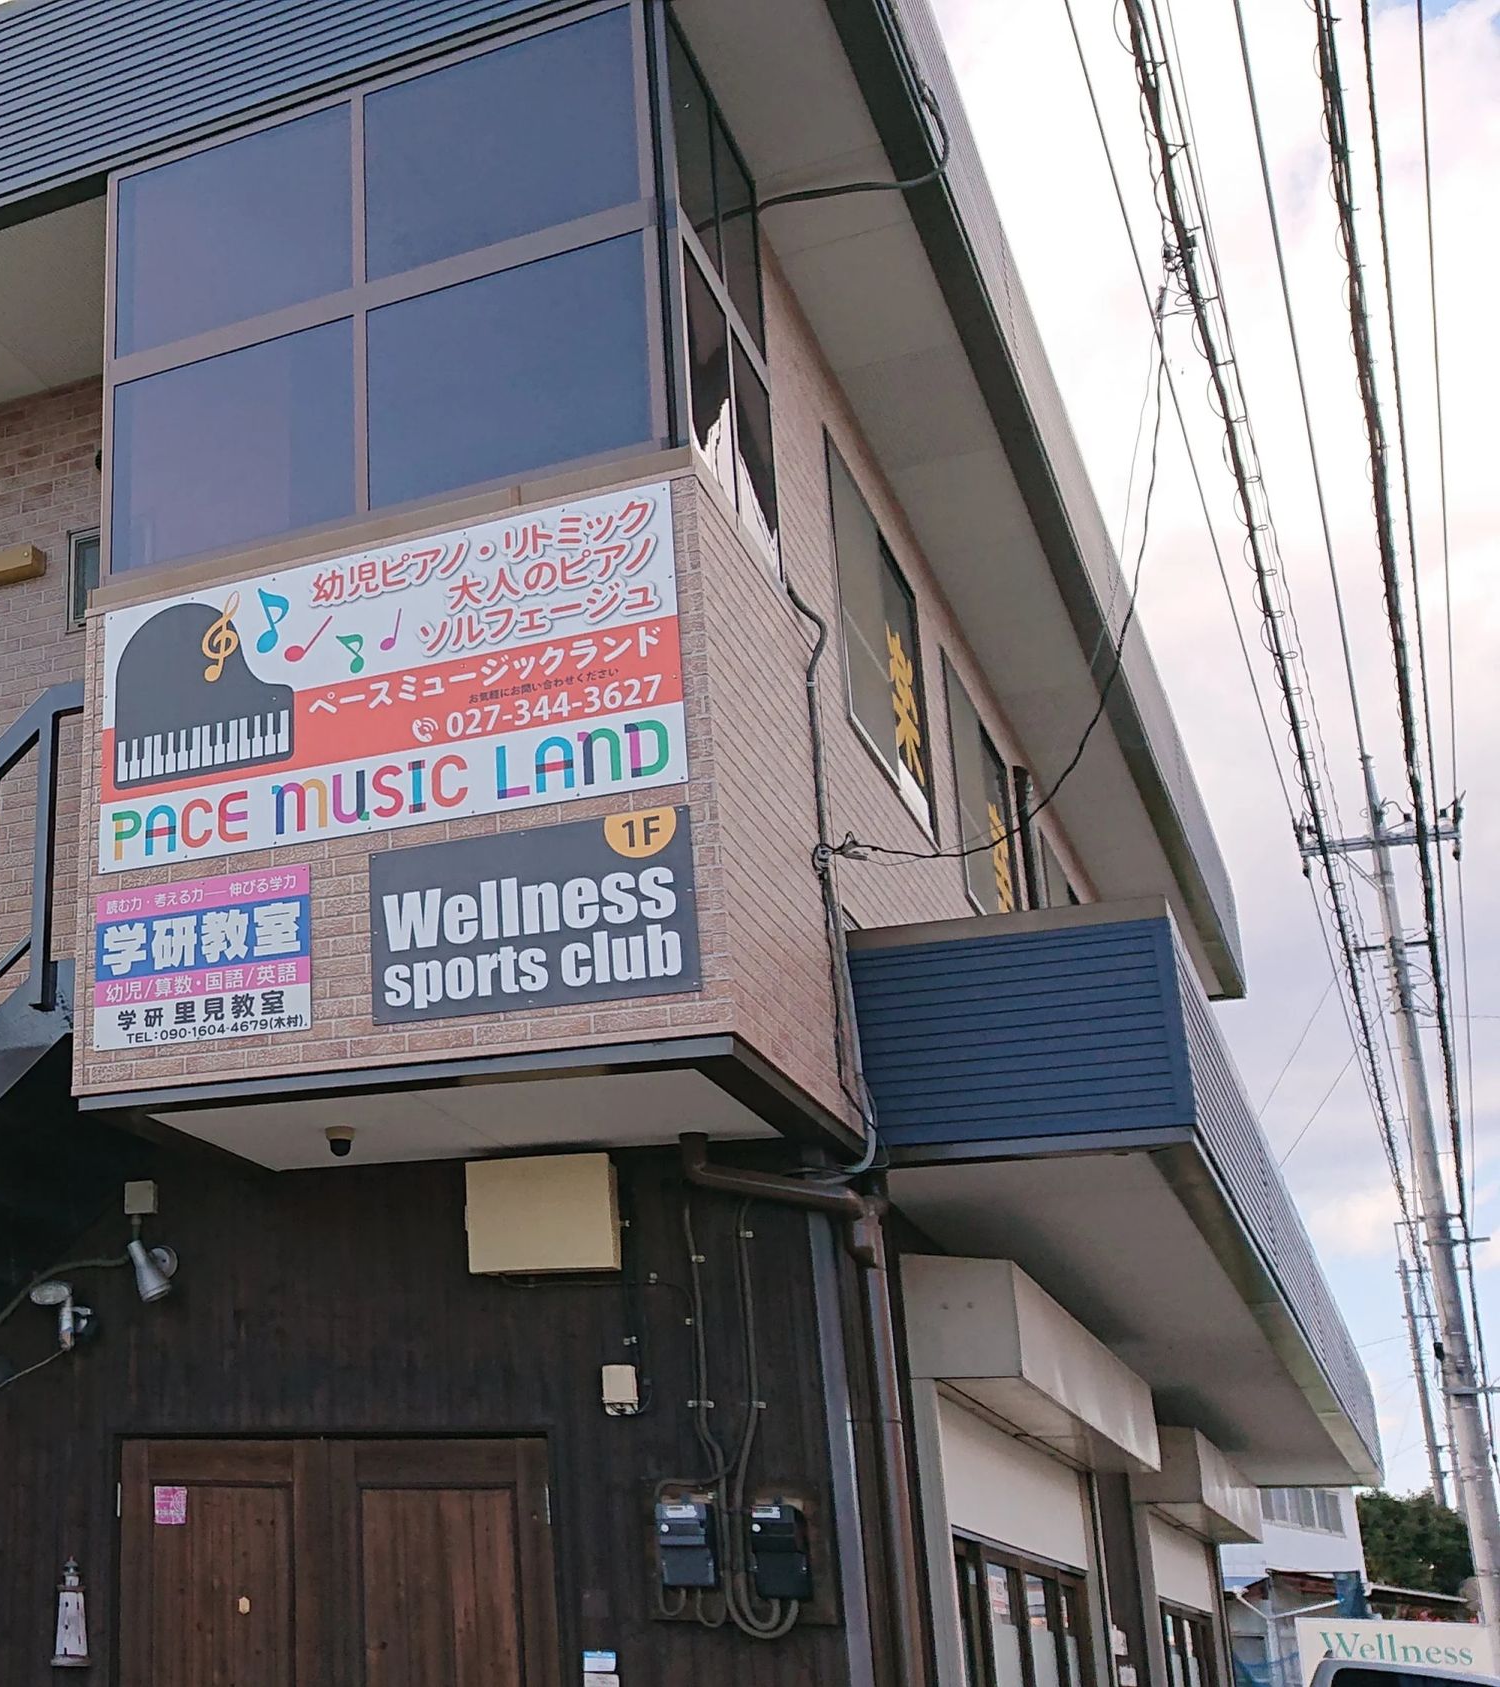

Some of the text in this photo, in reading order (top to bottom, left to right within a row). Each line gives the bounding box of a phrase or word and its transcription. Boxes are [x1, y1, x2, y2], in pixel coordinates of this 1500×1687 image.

[311, 500, 652, 602] 幼児ピアノ・リトミック
[449, 537, 654, 611] 大人のピアノ
[418, 584, 660, 654] ソルフェージュ
[308, 626, 661, 714] ペースミュージックランド
[446, 674, 662, 739] 027-344-3627
[468, 668, 619, 704] お気軽にお問い合わせください
[111, 790, 249, 862] PACE
[621, 814, 661, 848] 1F
[102, 900, 301, 976] 学研教室
[382, 866, 678, 953] Wellness
[383, 923, 683, 1010] sports club
[1319, 1631, 1474, 1666] Wellness
